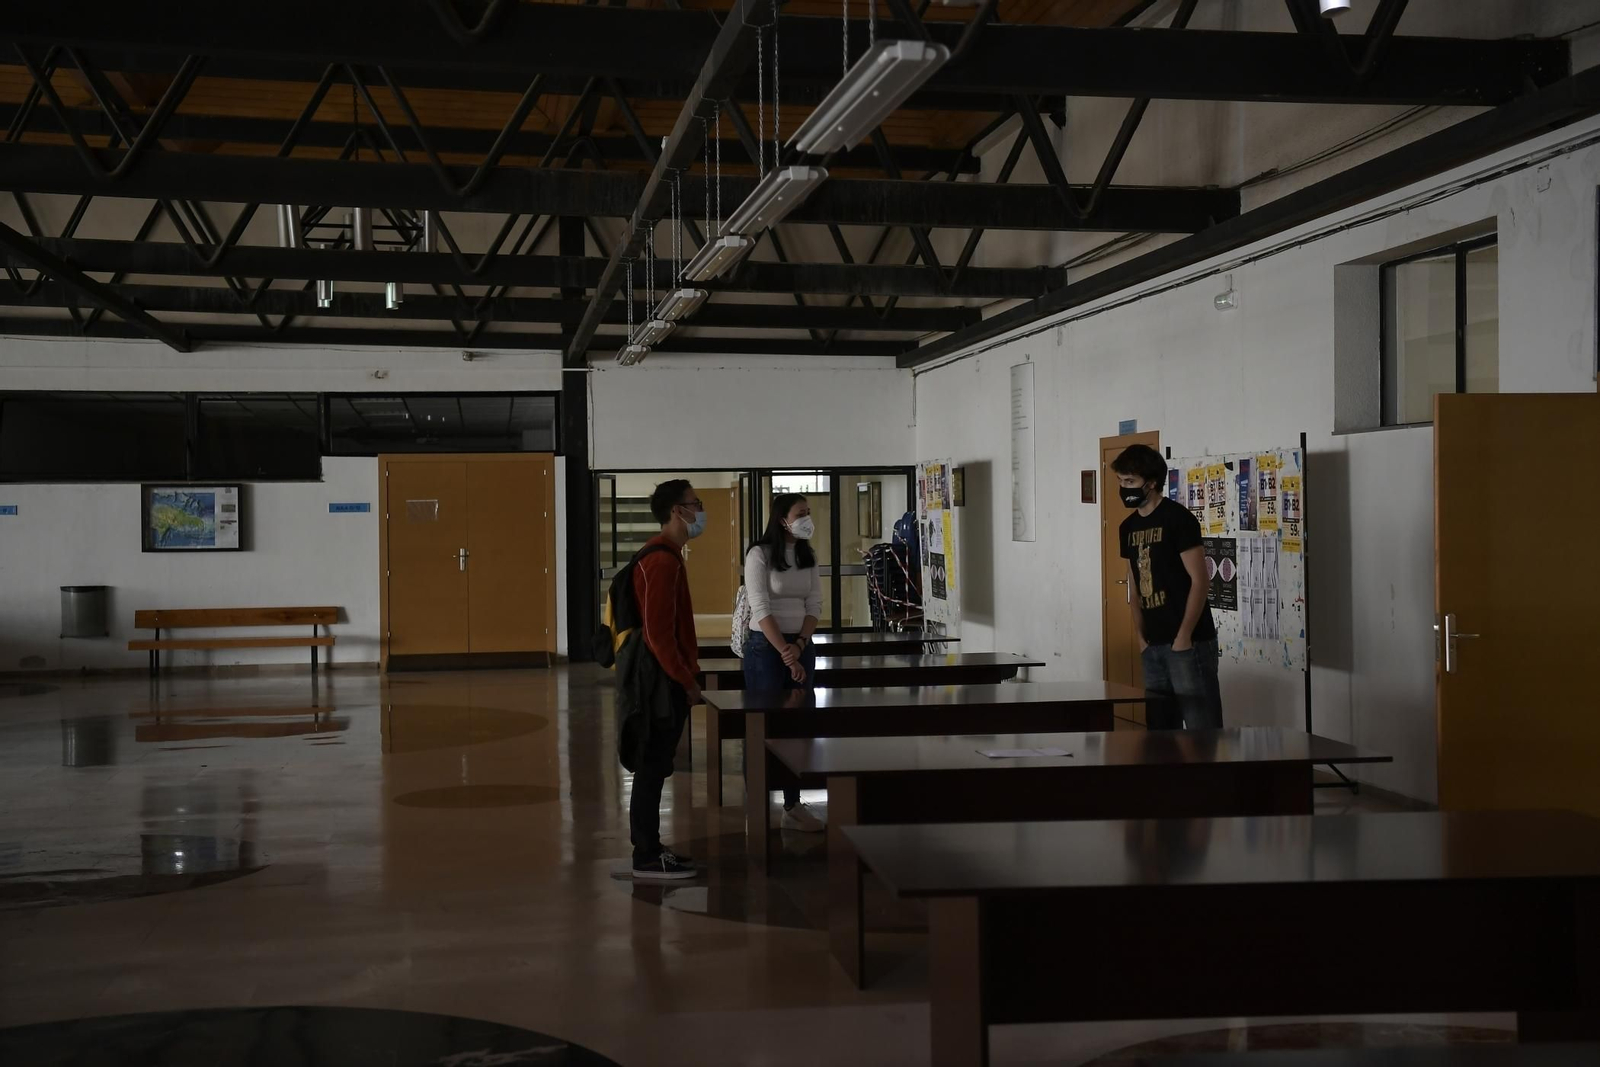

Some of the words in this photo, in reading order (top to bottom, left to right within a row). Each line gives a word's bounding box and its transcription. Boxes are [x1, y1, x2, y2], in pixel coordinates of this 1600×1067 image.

[1268, 477, 1276, 489] B2
[1197, 489, 1204, 500] B2
[1292, 499, 1300, 511] B2
